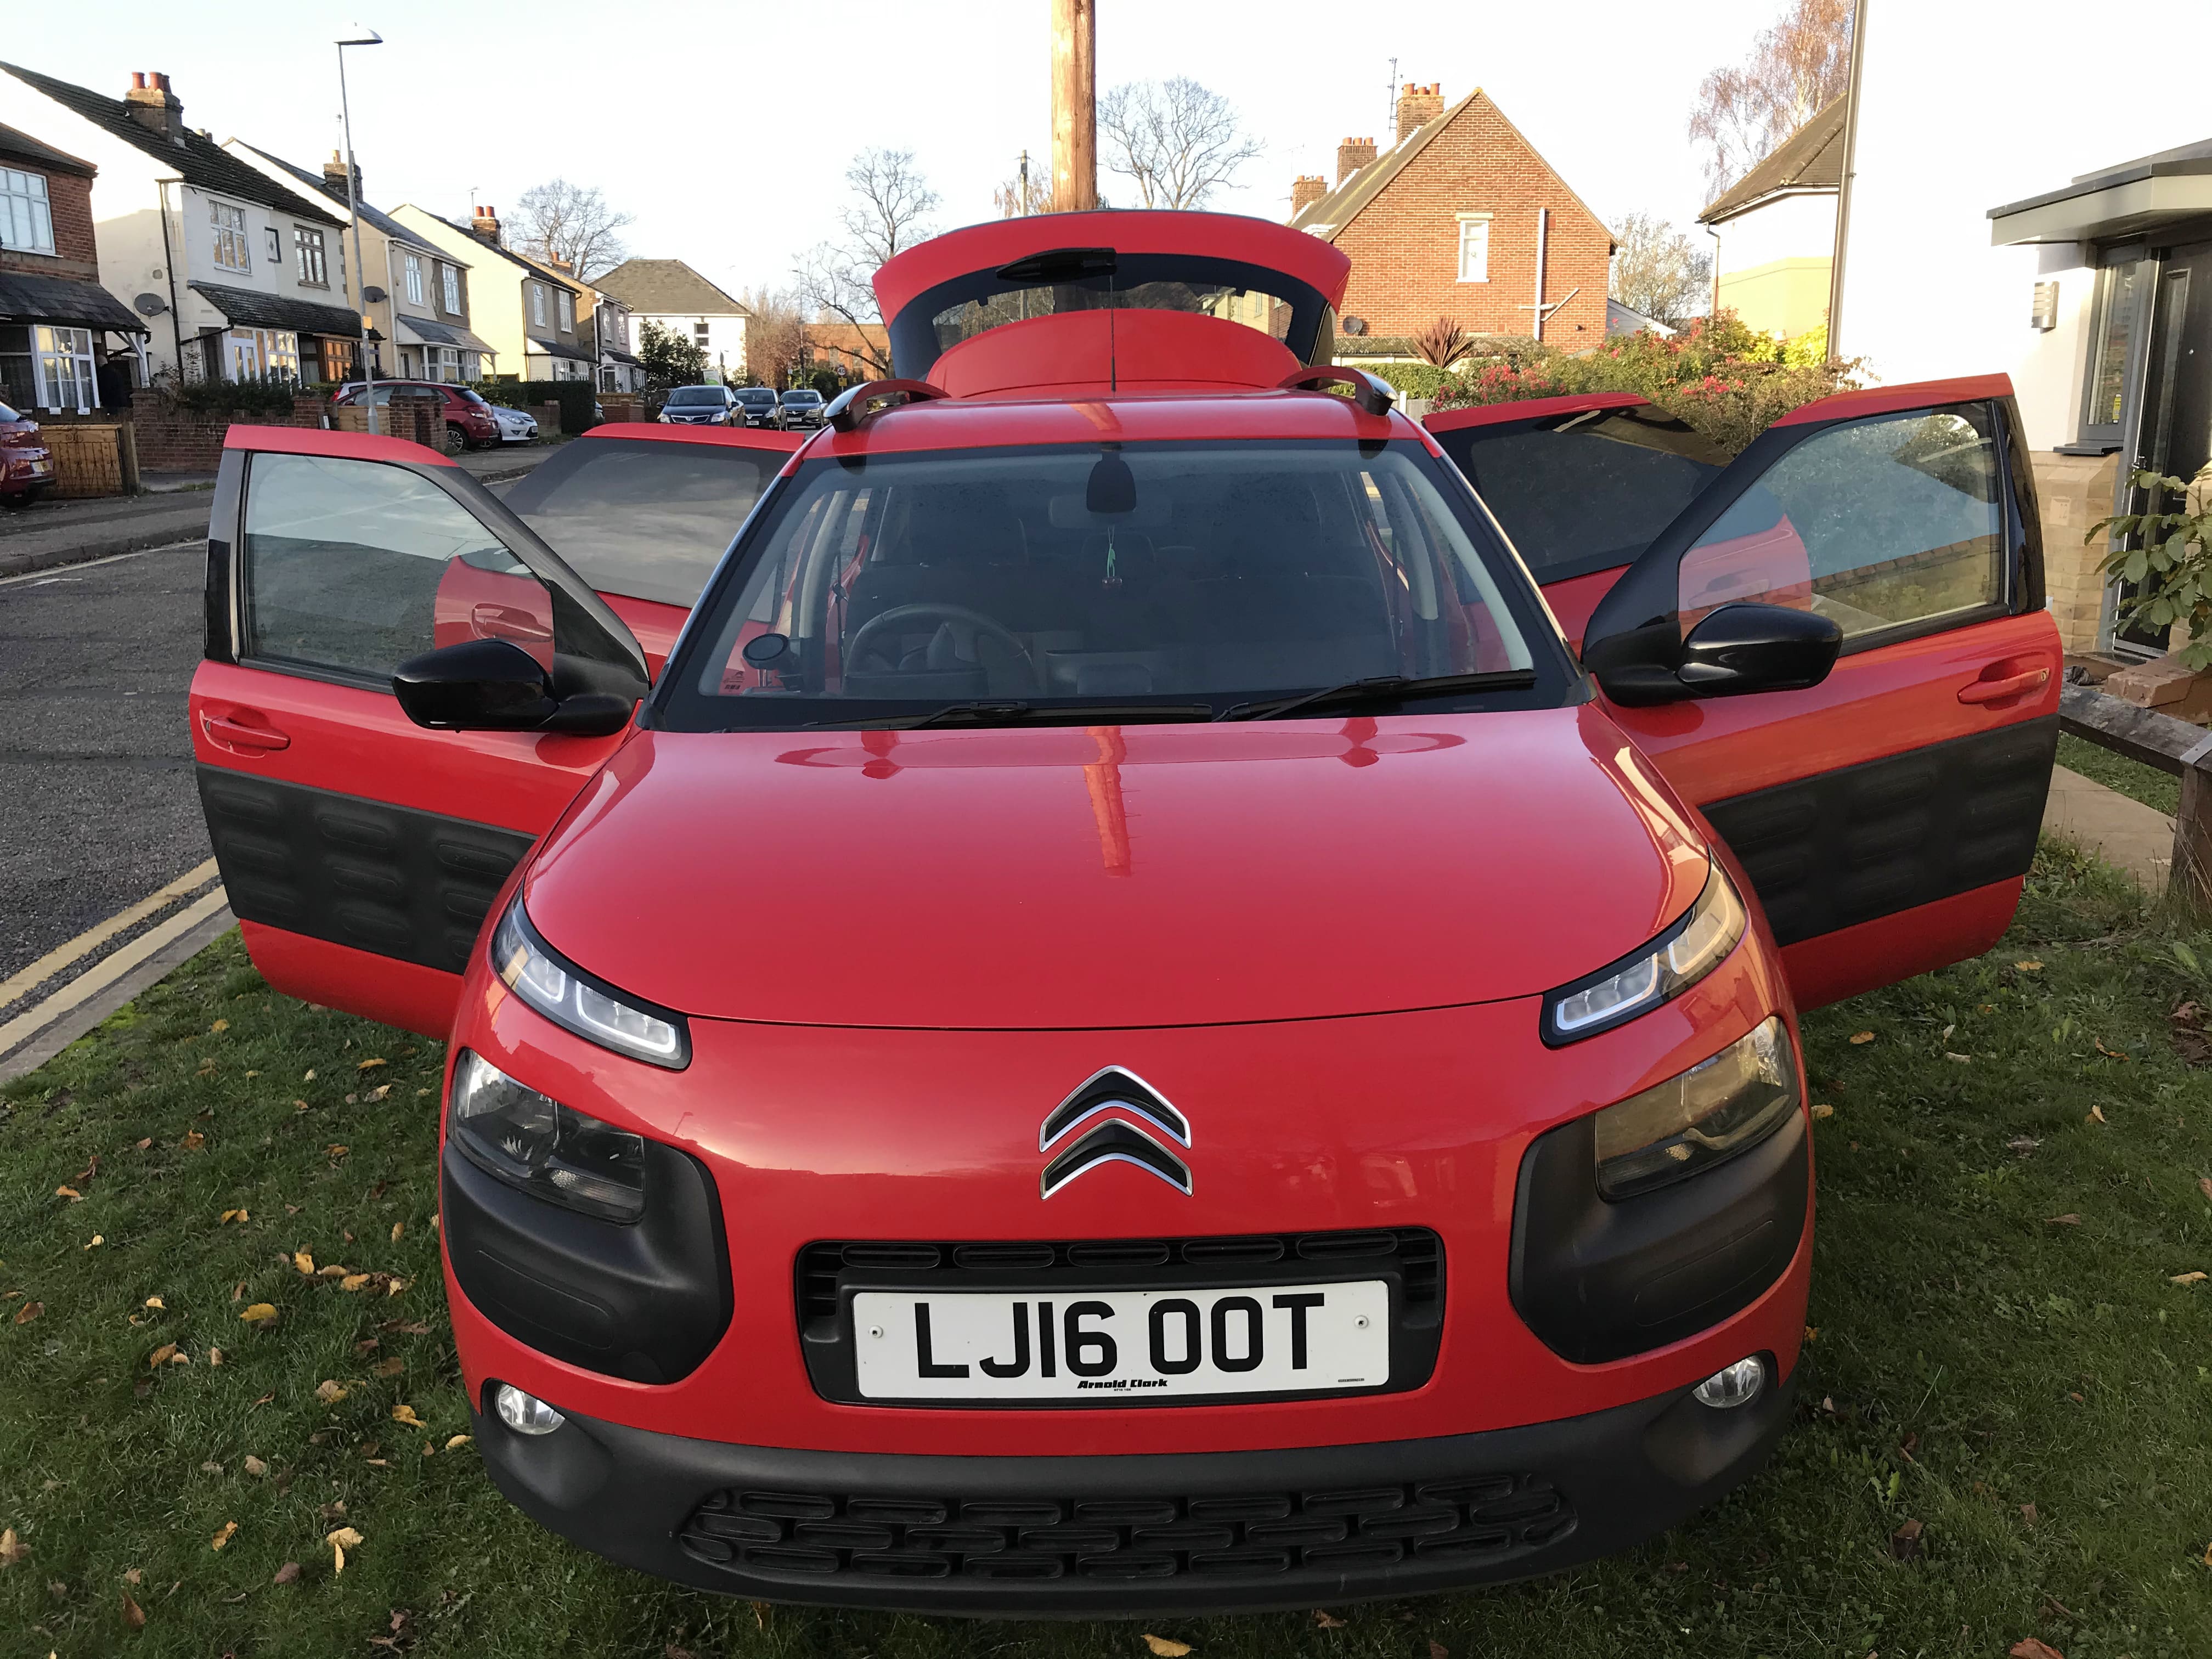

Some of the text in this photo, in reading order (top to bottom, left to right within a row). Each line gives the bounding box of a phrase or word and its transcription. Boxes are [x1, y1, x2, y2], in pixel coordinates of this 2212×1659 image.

[915, 1301, 1118, 1379] LJ16
[1077, 1379, 1168, 1389] Arnold Clark
